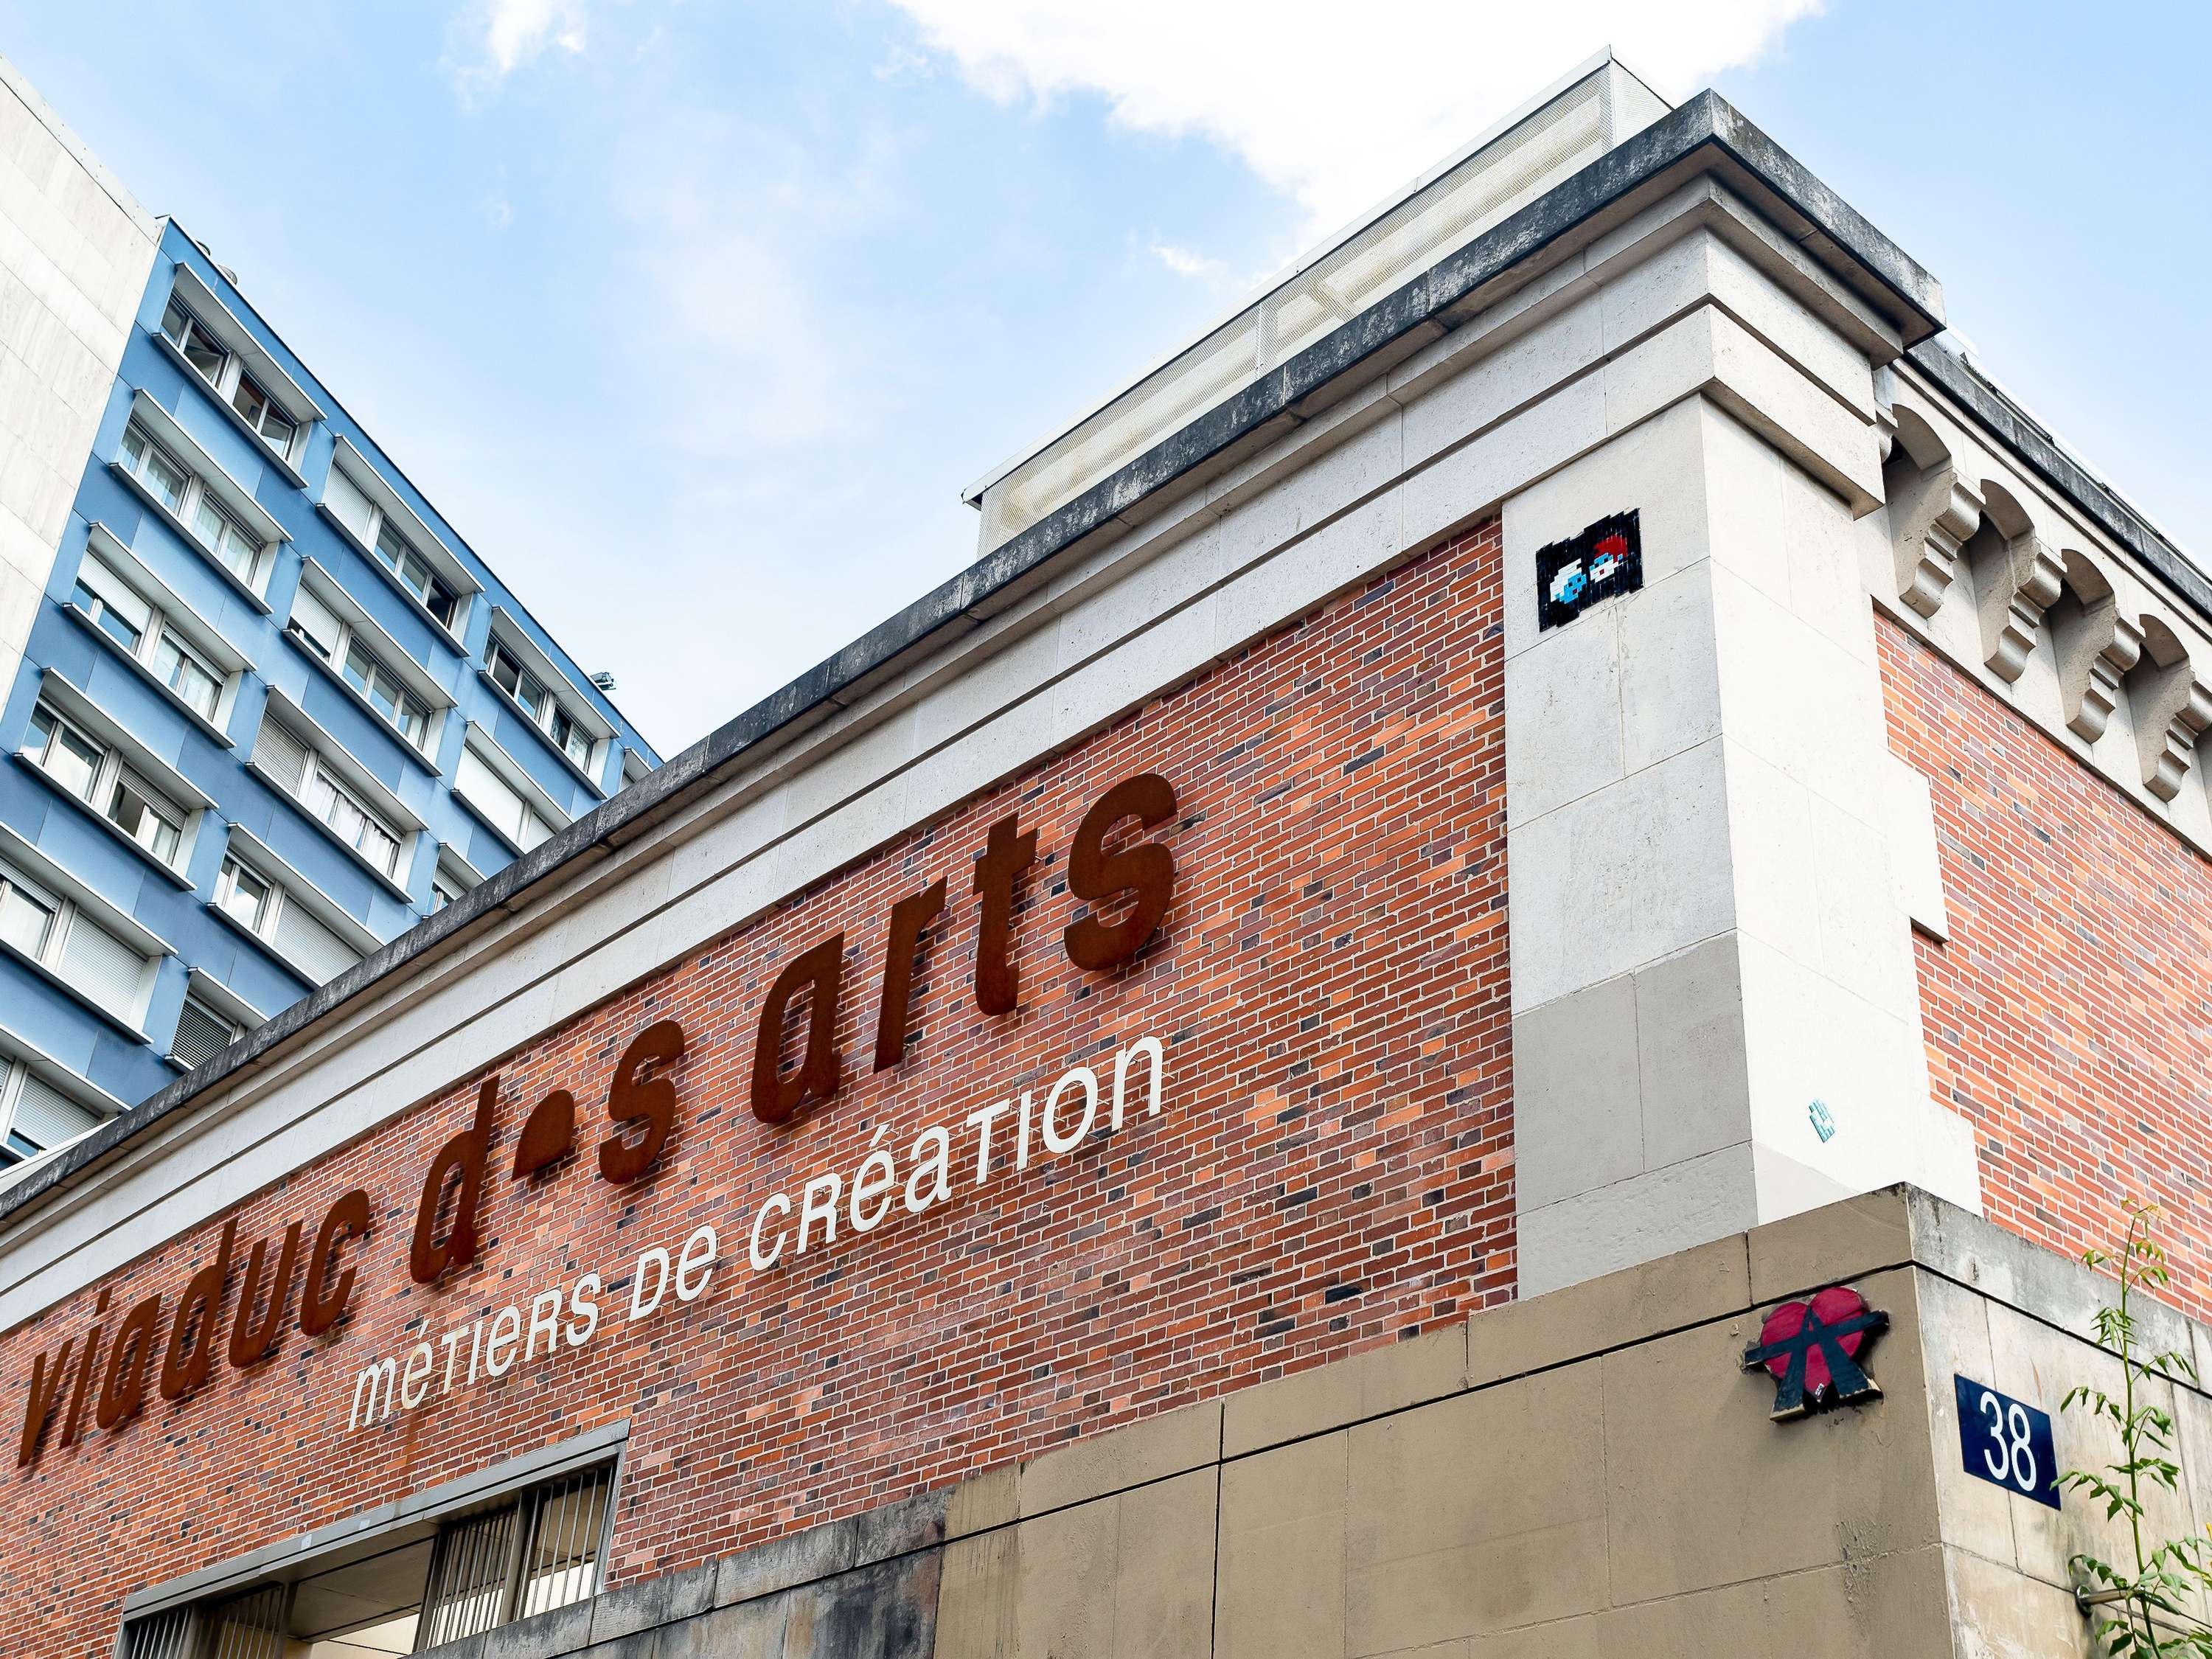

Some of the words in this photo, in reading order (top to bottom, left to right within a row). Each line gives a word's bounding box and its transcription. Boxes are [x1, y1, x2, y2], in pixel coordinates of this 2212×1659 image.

[18, 1189, 370, 1469] viaduc
[751, 773, 1178, 1123] arts
[1980, 1391, 2037, 1492] 38
